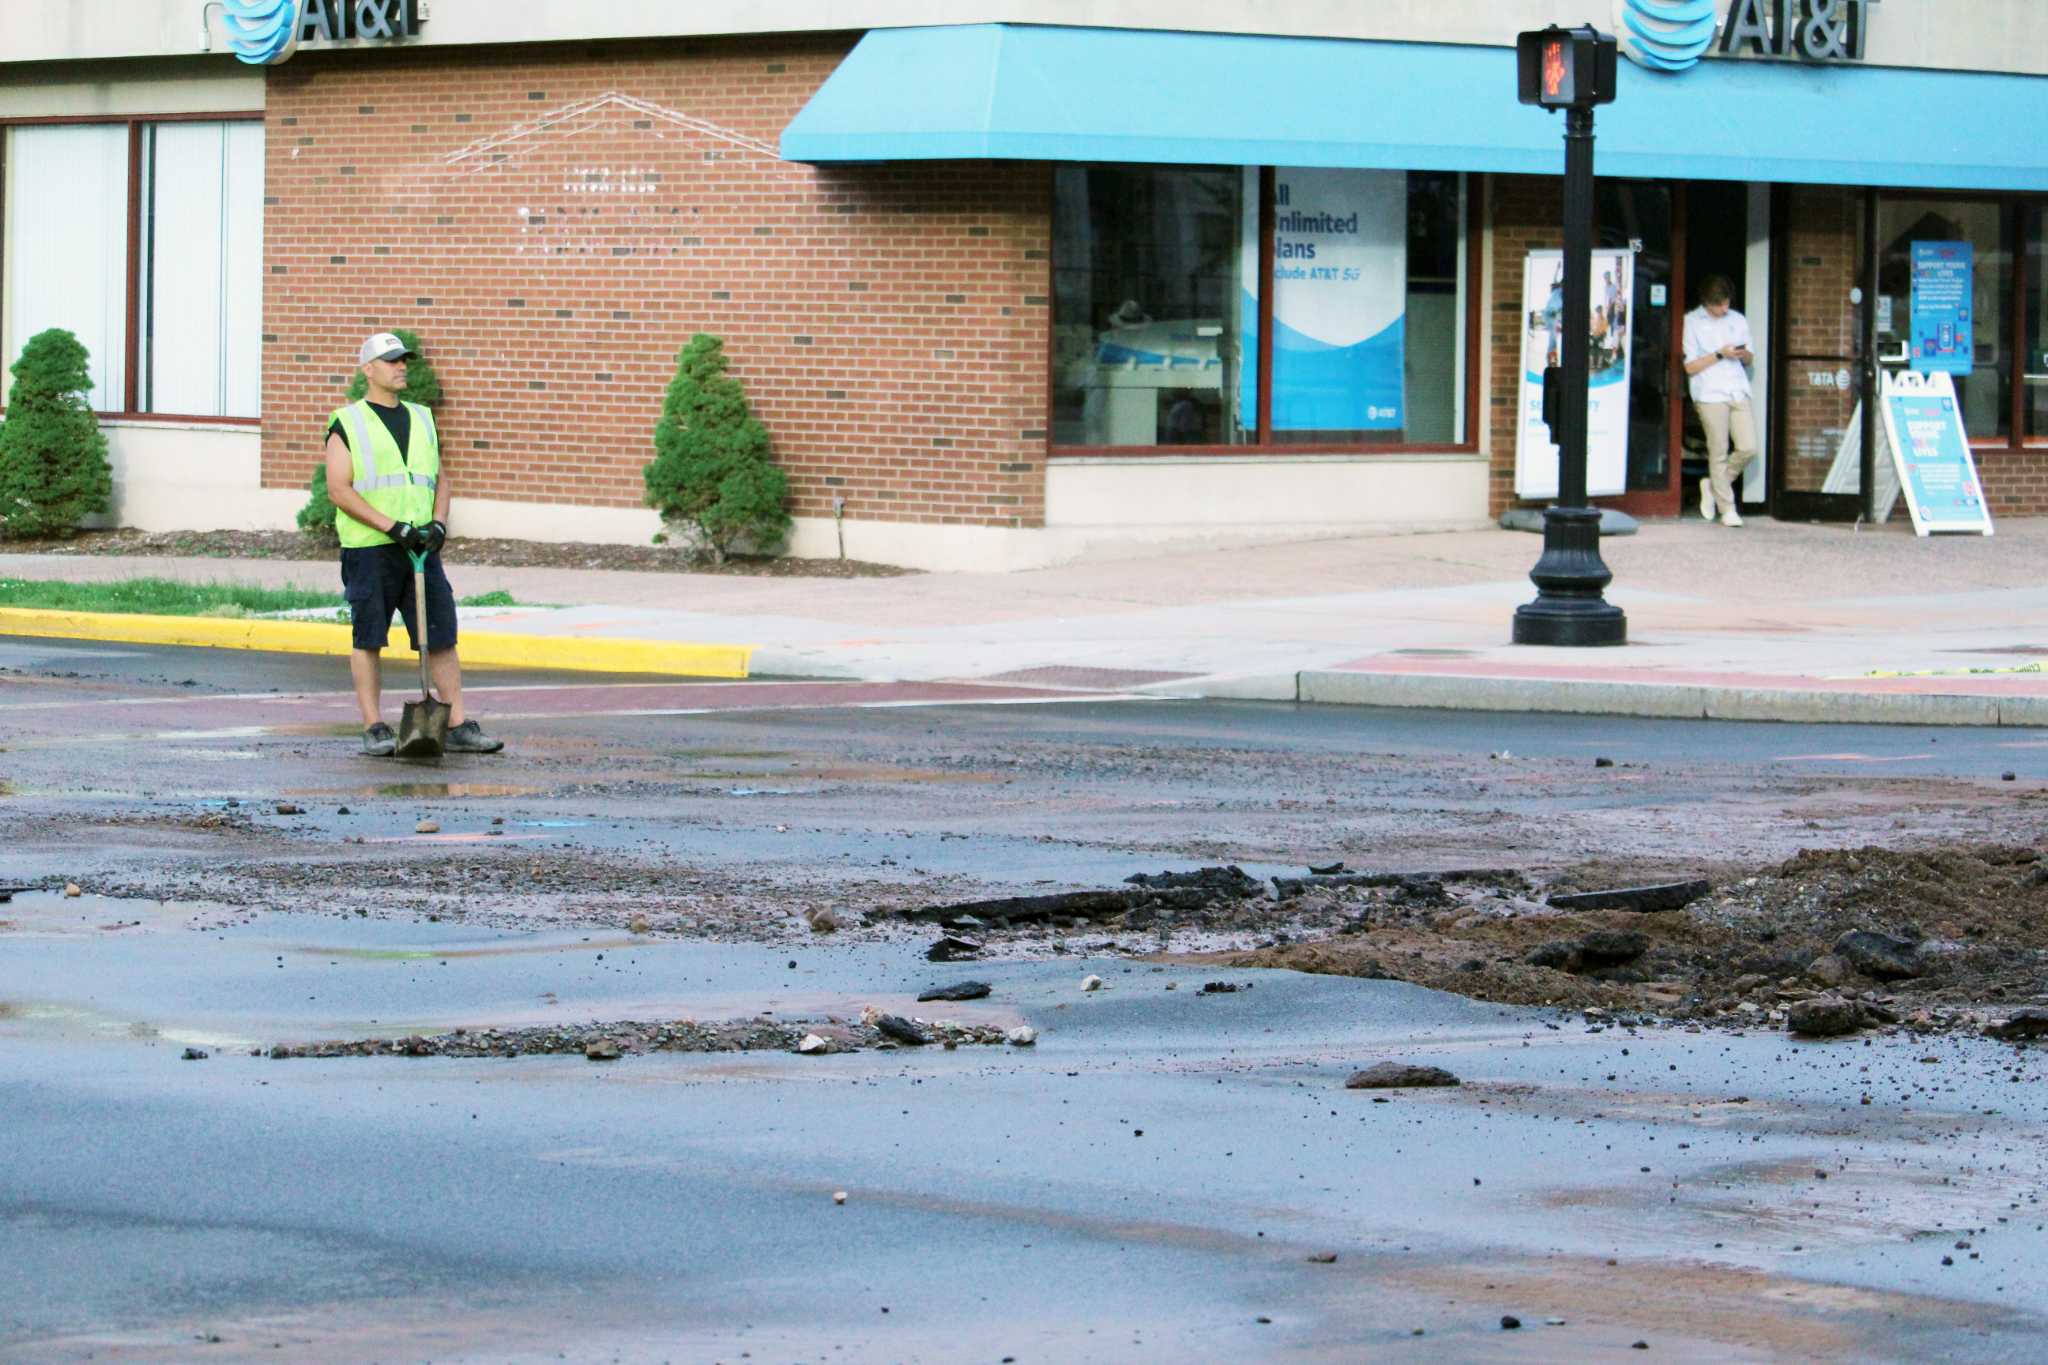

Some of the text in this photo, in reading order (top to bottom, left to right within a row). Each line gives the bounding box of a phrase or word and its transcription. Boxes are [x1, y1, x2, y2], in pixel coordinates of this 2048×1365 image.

[1719, 0, 1880, 60] AT&T
[1275, 183, 1290, 206] ll
[1275, 211, 1358, 234] nlimited
[1275, 236, 1317, 260] lans
[1274, 266, 1306, 280] clude
